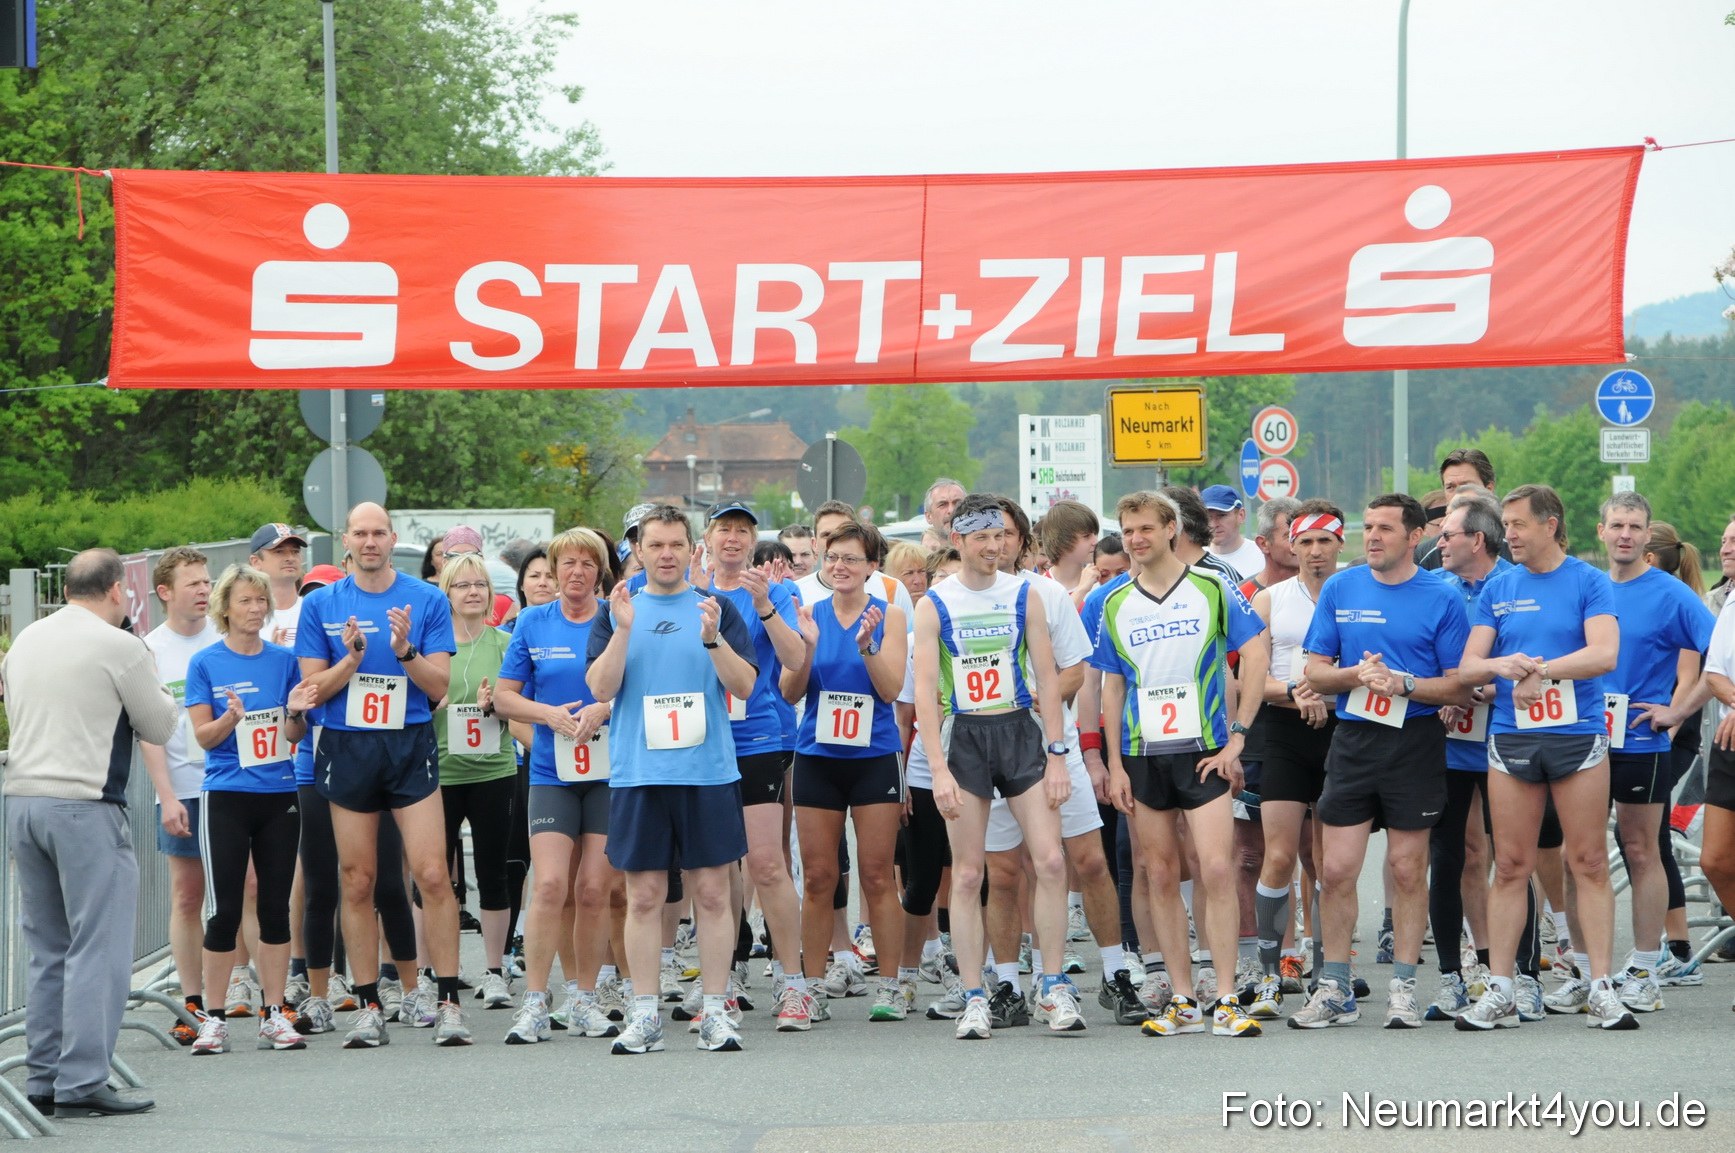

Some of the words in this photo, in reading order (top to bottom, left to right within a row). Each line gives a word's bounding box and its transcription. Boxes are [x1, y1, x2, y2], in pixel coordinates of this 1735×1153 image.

[1144, 402, 1170, 411] Nach
[1120, 415, 1194, 434] Neumarkt
[1264, 421, 1288, 442] 60
[1146, 440, 1152, 449] 5
[1158, 441, 1172, 449] km
[1606, 450, 1632, 458] Verkehr
[1633, 450, 1646, 458] frei
[1038, 467, 1054, 485] SHB
[959, 624, 1013, 639] BOCK
[1129, 619, 1200, 647] BOCK
[961, 655, 988, 665] MEYER
[962, 662, 989, 670] WERBUNG
[359, 676, 385, 685] MEYER
[967, 669, 1002, 703] 92
[653, 696, 682, 704] MEYER
[828, 694, 853, 702] MEYER
[1147, 687, 1174, 697] MEYER
[1148, 694, 1176, 702] WERBUNG
[363, 692, 390, 725] 61
[245, 712, 271, 722] MEYER
[832, 708, 860, 740] 10
[1161, 703, 1179, 735] 2
[467, 718, 481, 748] 5
[667, 710, 679, 741] 1
[252, 726, 278, 760] 67
[574, 743, 590, 775] 9
